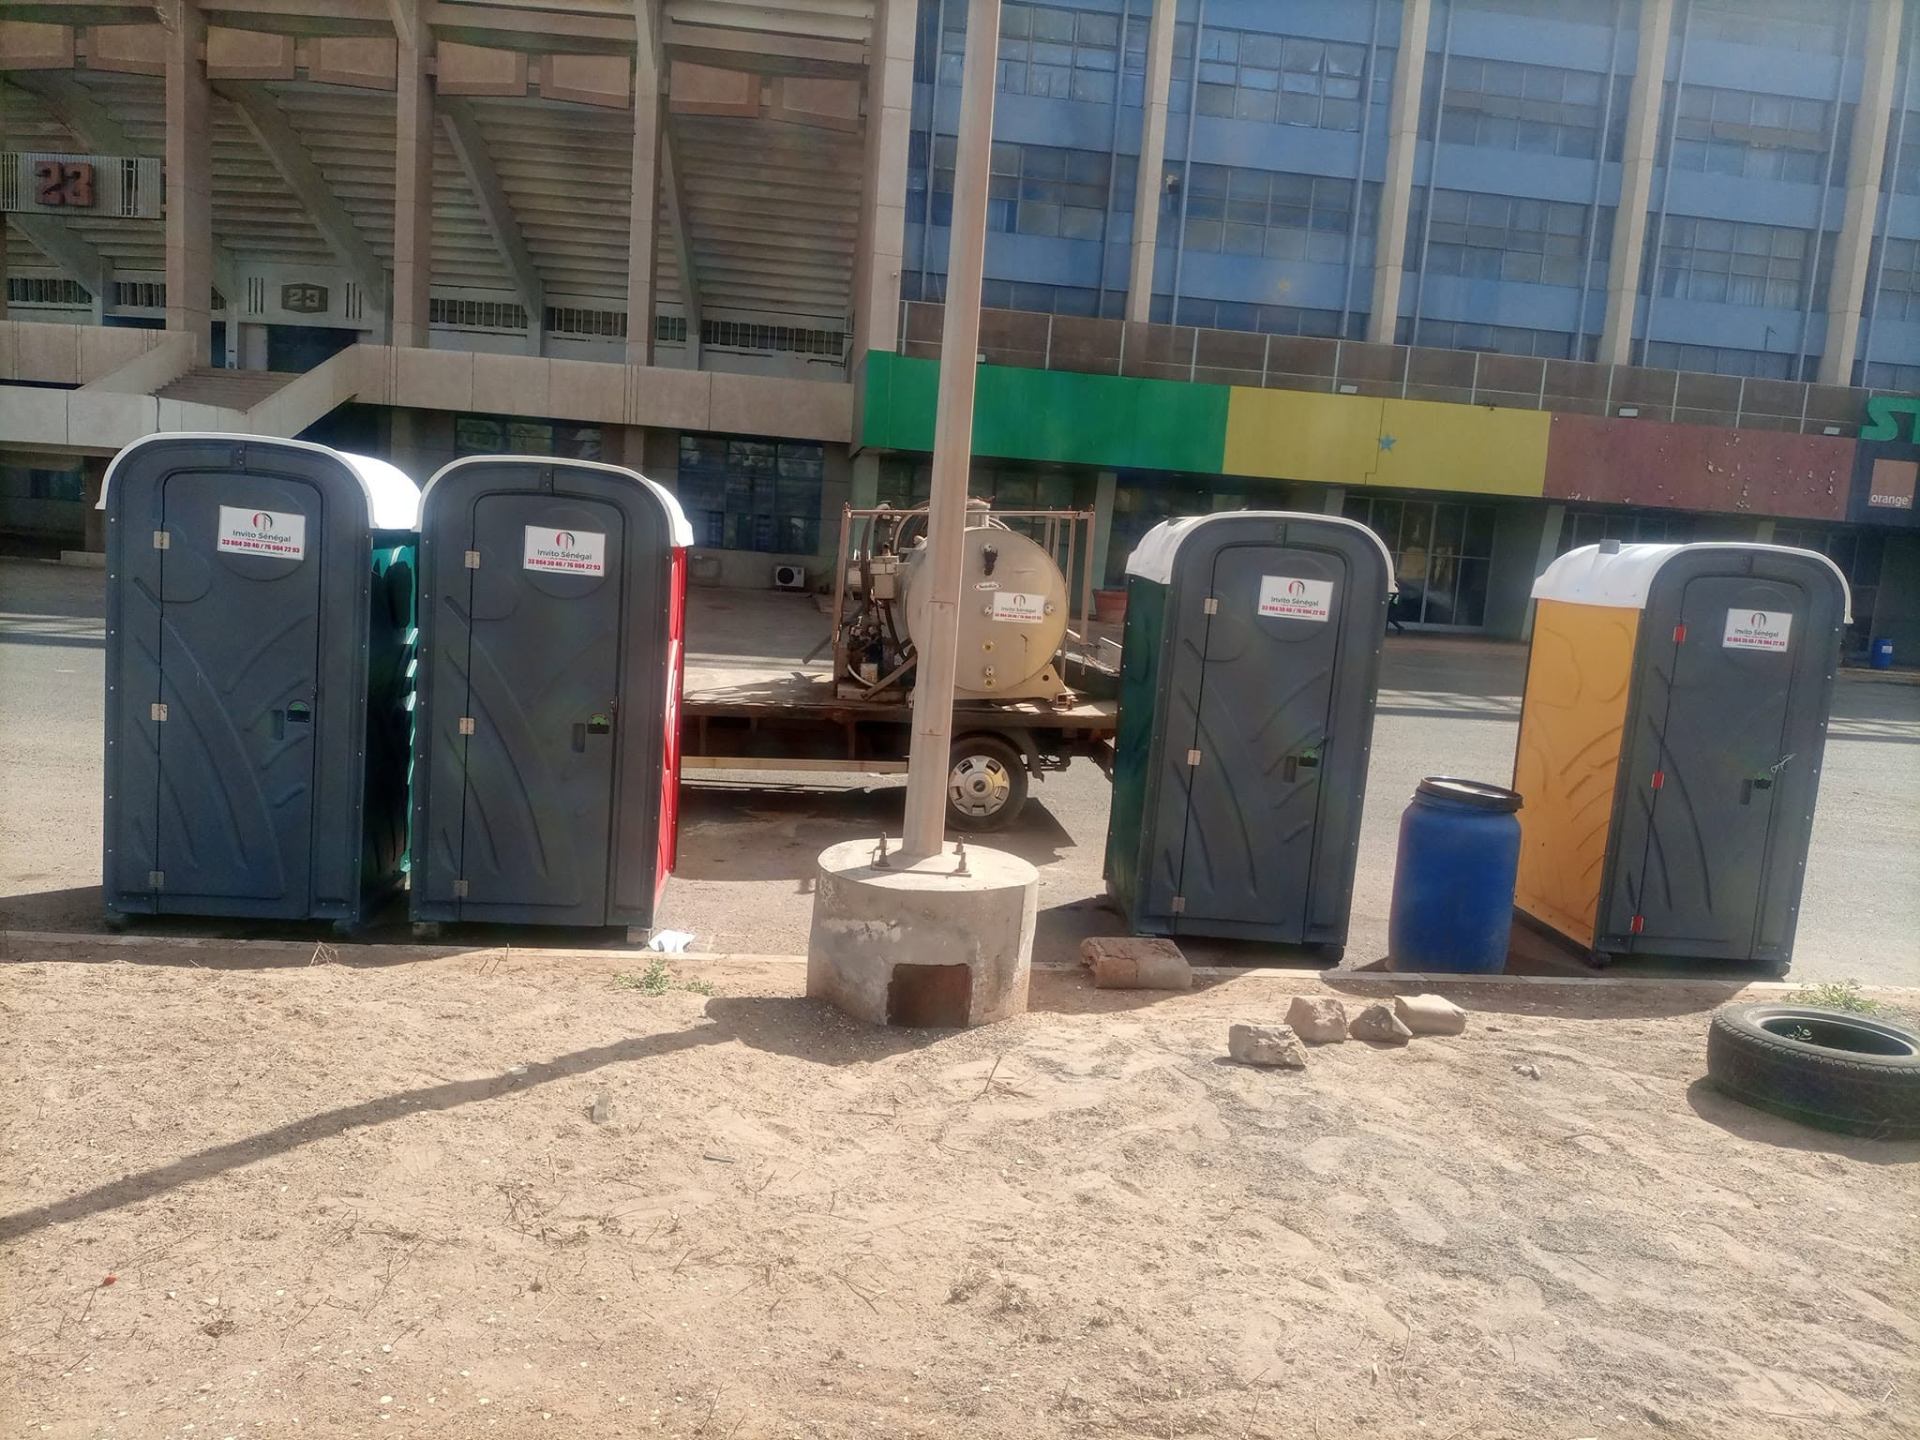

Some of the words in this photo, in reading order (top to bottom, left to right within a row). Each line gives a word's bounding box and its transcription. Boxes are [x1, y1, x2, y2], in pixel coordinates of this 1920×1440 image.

[35, 160, 93, 207] 23
[287, 288, 320, 308] 23
[1871, 494, 1909, 506] orange
[233, 530, 257, 539] Invito
[258, 533, 291, 544] Sénégal
[538, 550, 560, 558] Invito
[561, 552, 592, 561] Sénégal
[1291, 599, 1319, 607] Sénégal
[1753, 630, 1779, 638] Sénégal
